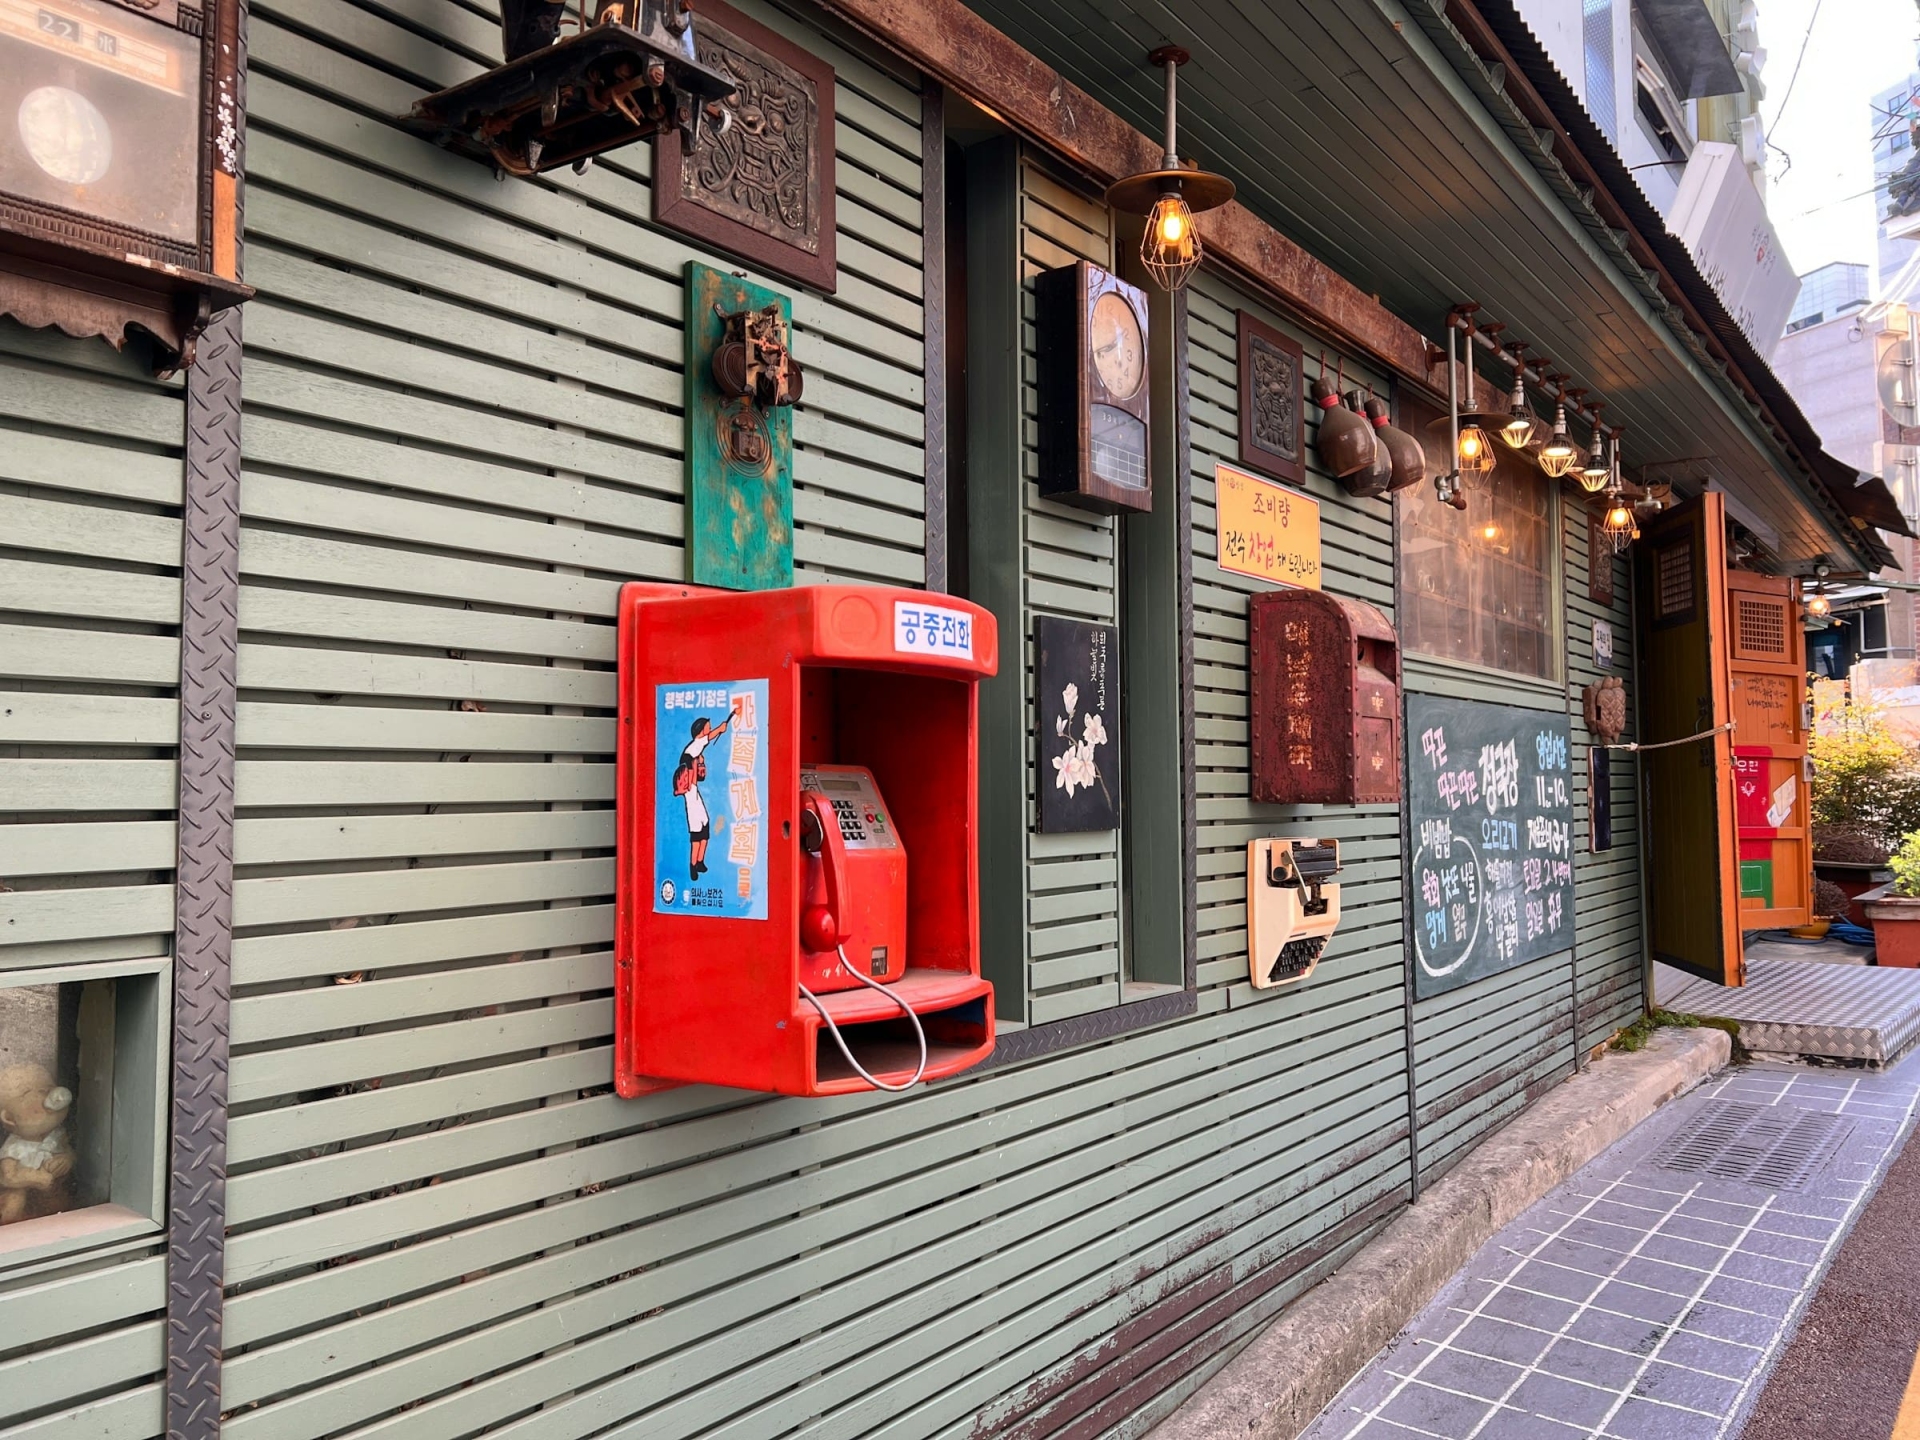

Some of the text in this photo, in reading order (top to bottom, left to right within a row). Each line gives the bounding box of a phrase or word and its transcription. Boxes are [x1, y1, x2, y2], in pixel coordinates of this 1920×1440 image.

[1253, 492, 1291, 528] 조비량
[900, 609, 970, 651] 공중전화
[664, 689, 728, 711] 행복한 가정은
[1536, 729, 1567, 771] 영업시간
[1737, 759, 1760, 773] 우편
[1478, 737, 1519, 816] 청국장
[1420, 817, 1453, 860] 비빔밥
[1481, 818, 1518, 851] 오리고기
[1425, 906, 1447, 950] 멍게
